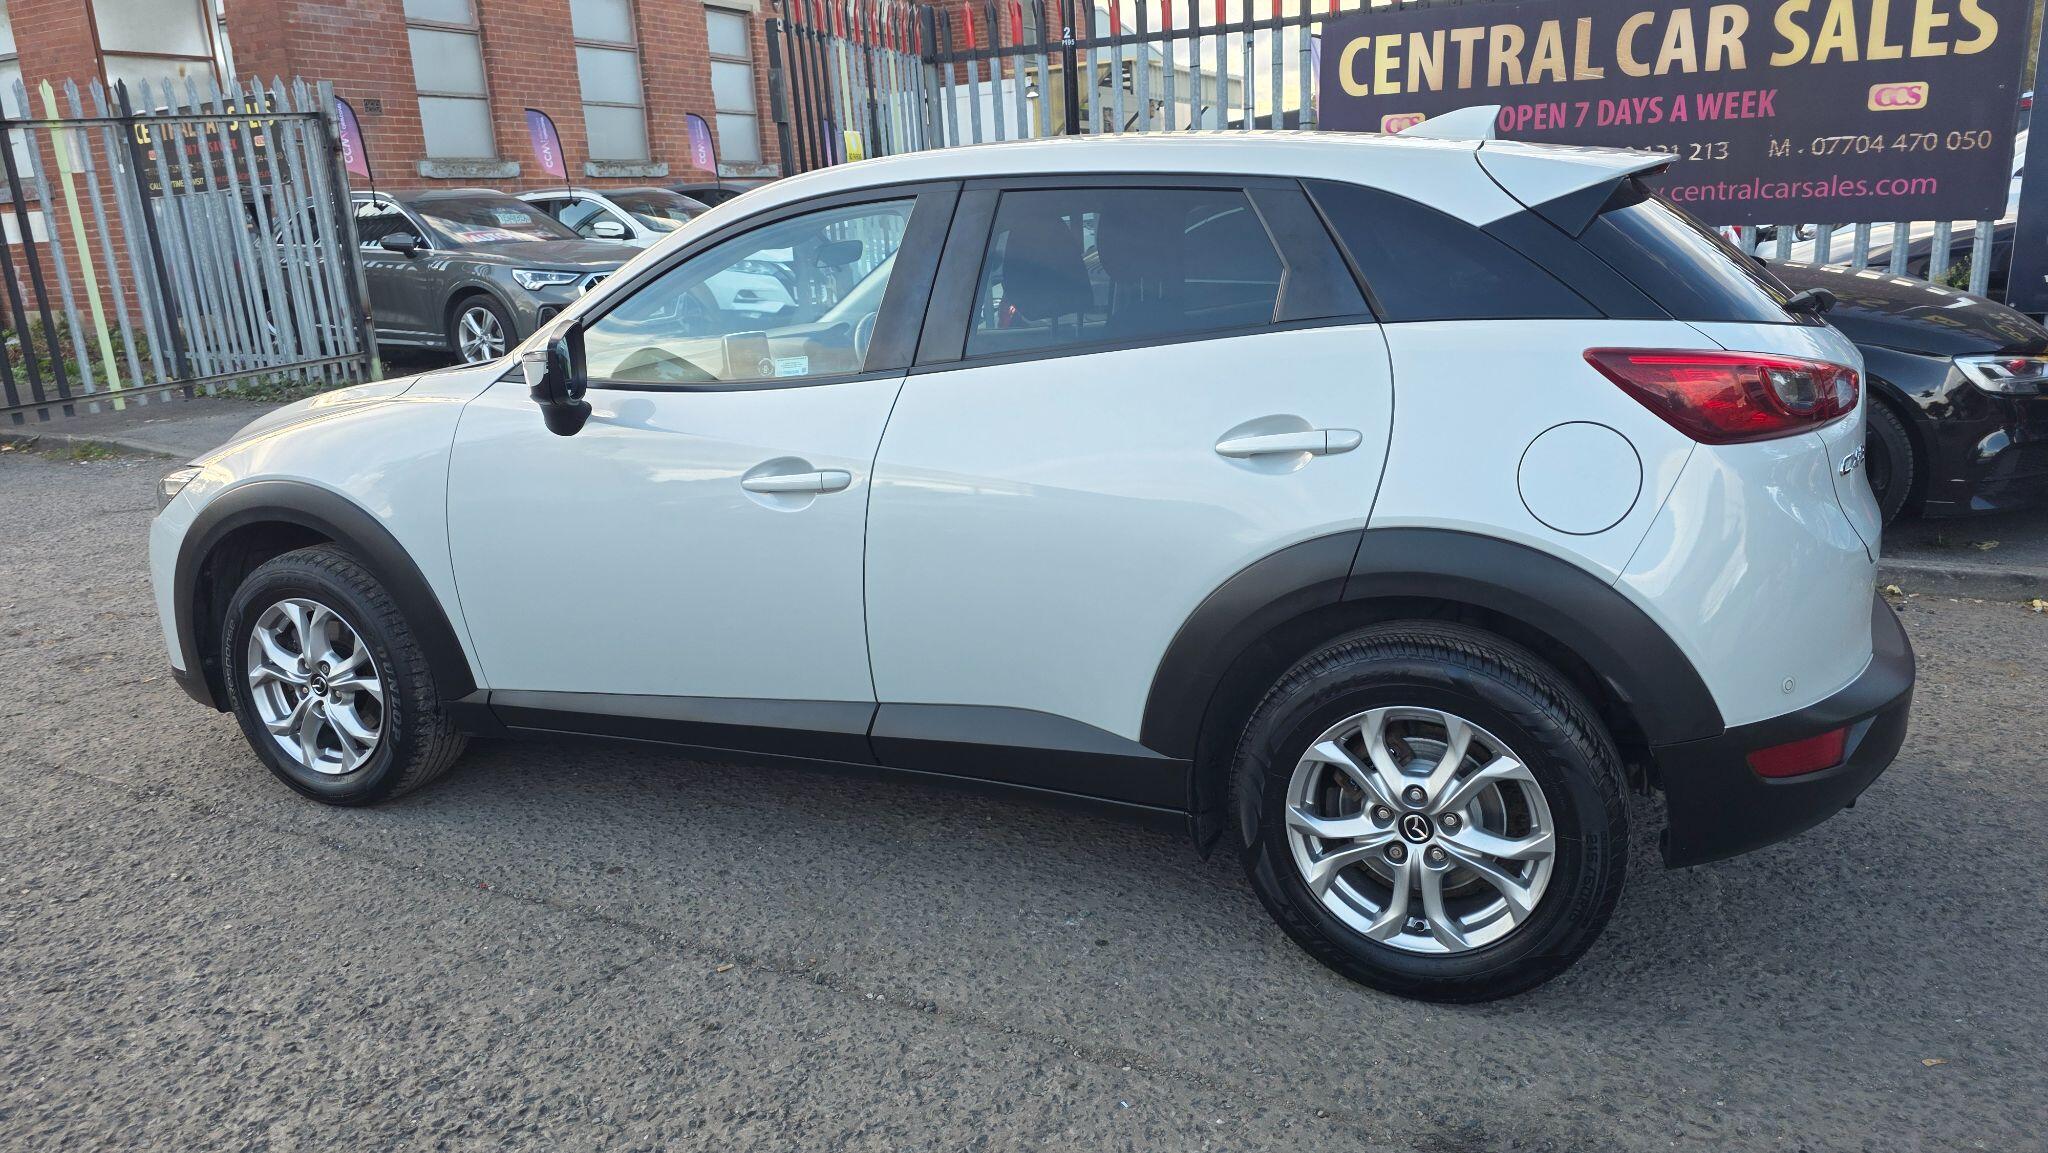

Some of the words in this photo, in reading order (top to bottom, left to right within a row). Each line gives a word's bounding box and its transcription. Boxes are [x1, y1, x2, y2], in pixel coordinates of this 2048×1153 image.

[1339, 17, 1604, 96] CENTRAL
[1616, 4, 1746, 77] CAR
[1769, 0, 1998, 67] SALES
[1499, 102, 1567, 132] OPEN
[1575, 102, 1590, 128] 7
[1597, 97, 1663, 126] DAYS
[1670, 94, 1688, 122] A
[1697, 89, 1778, 121] WEEK
[1688, 141, 1730, 161] 213
[1811, 135, 1885, 155] 07704
[1892, 133, 1938, 152] 470
[1946, 130, 1992, 150] 050
[1660, 175, 1937, 202] centralcarsales.com
[377, 646, 400, 740] DUNLOP
